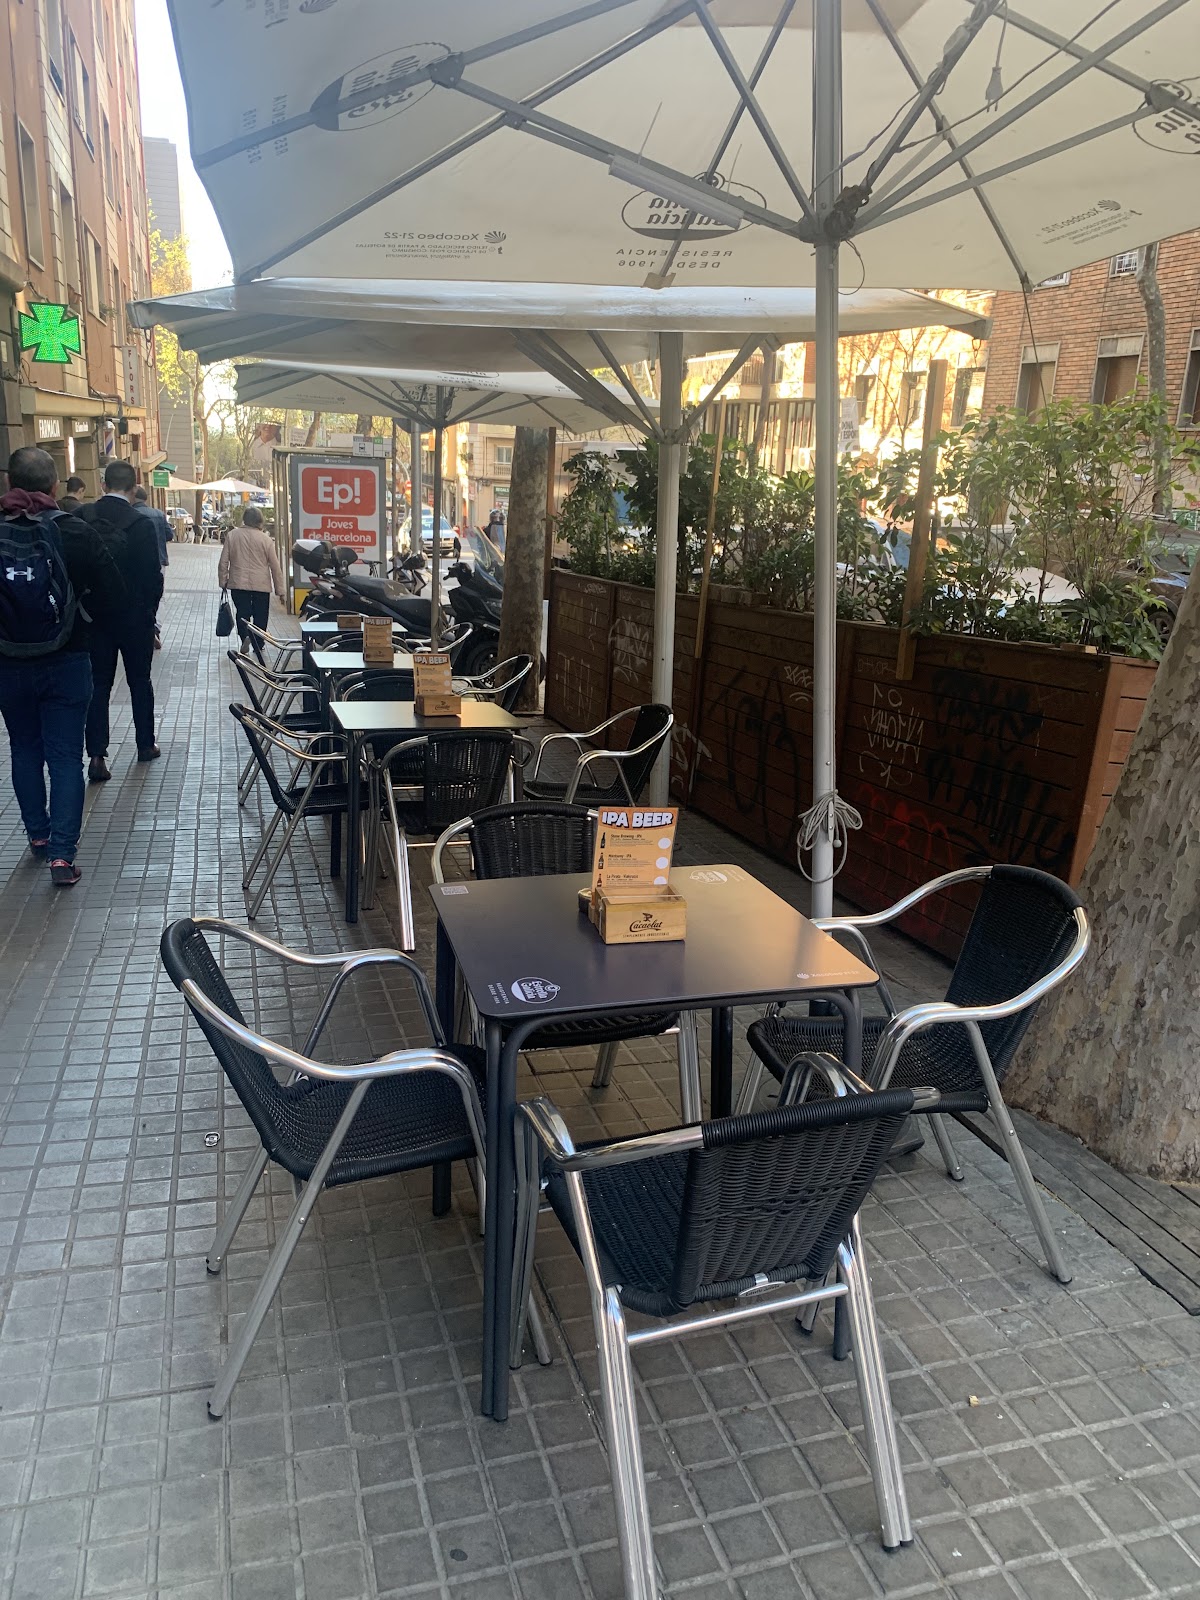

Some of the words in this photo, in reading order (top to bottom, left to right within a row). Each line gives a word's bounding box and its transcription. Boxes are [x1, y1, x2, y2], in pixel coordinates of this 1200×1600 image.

[127, 349, 135, 405] FLORS
[318, 476, 360, 510] Ep!
[327, 519, 353, 529] Joves
[308, 531, 322, 540] de
[324, 532, 372, 543] Barcelona
[415, 656, 427, 664] IPA
[429, 656, 448, 665] BEER
[602, 811, 629, 828] IPA
[632, 811, 673, 828] BEER
[630, 920, 663, 932] Cacaolat
[521, 982, 537, 999] Galicia
[532, 981, 548, 998] Estrella
